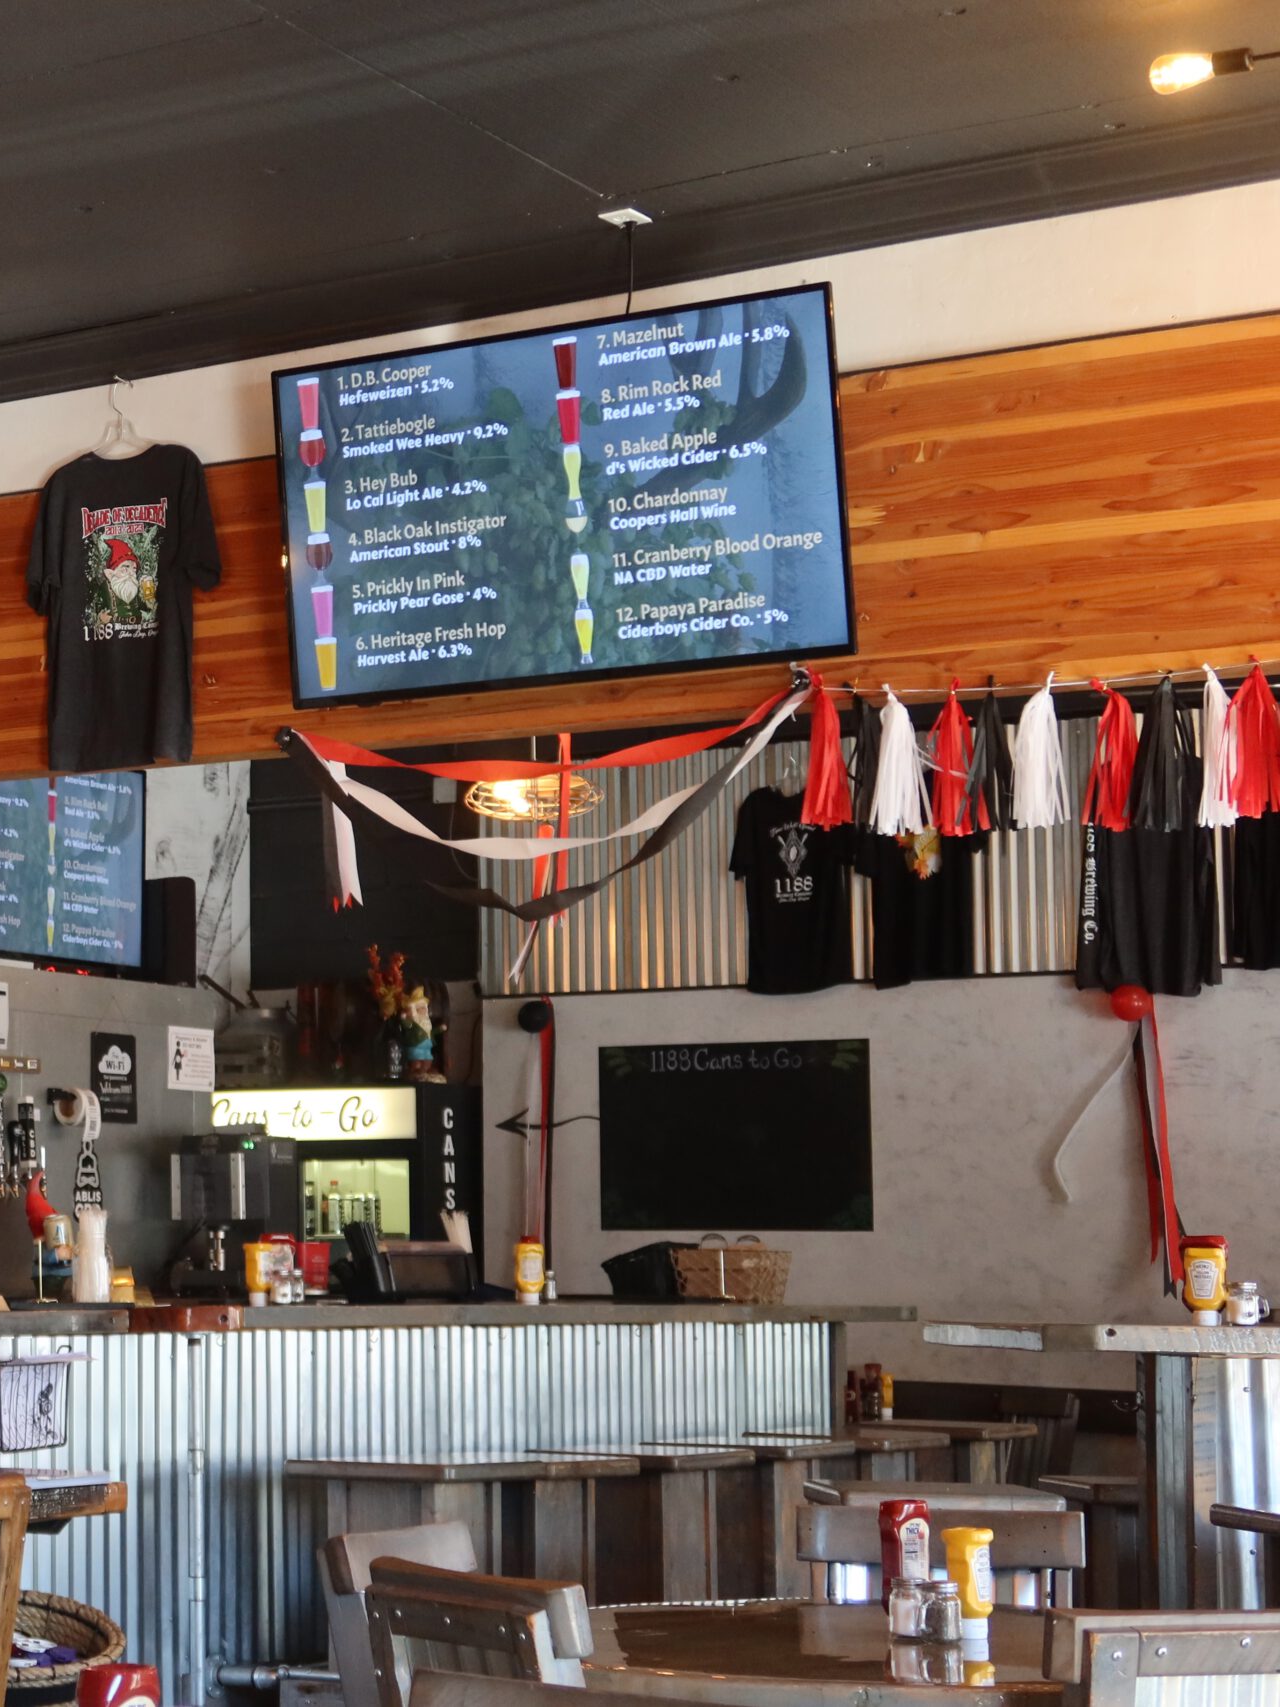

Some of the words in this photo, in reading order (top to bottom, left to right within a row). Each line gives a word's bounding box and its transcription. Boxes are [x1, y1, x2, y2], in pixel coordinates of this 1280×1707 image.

[597, 334, 610, 349] 7.
[613, 323, 684, 347] Mazelnut
[599, 342, 666, 366] American
[669, 337, 715, 355] Brown
[719, 333, 742, 347] Ale
[752, 325, 790, 342] 5.8%
[337, 376, 348, 390] 1.
[352, 373, 379, 388] D.B.
[382, 364, 431, 384] Cooper
[602, 389, 615, 404] 8.
[618, 383, 648, 401] Rim
[652, 376, 689, 395] Rock
[693, 371, 721, 389] Red
[340, 384, 412, 406] Hefeweizen
[421, 378, 454, 393] 5.2%
[603, 405, 629, 422] Red
[632, 401, 654, 416] Ale
[665, 396, 700, 412] 5.5%
[341, 428, 353, 442] 2.
[356, 415, 435, 440] Tattiebogle
[343, 443, 393, 458] Smoked
[396, 436, 422, 449] Wee
[425, 429, 464, 447] Heavy
[474, 424, 508, 439] 9.2%
[604, 444, 617, 459] 9.
[621, 433, 668, 456] Baked
[672, 428, 717, 453] Apple
[606, 459, 625, 476] d's
[629, 454, 679, 473] Wicked
[682, 450, 719, 465] Cider
[729, 442, 767, 458] 6.5%
[345, 481, 357, 494] 3.
[360, 477, 387, 493] Hey
[390, 470, 417, 484] Bub
[346, 496, 360, 511] Lo
[364, 492, 384, 507] Cal
[387, 488, 419, 507] Light
[422, 486, 442, 502] Ale
[452, 480, 486, 496] 4.2%
[608, 498, 631, 513] 10.
[634, 487, 727, 512] Chardonnay
[349, 532, 361, 546] 4.
[365, 526, 401, 544] Black
[404, 523, 432, 537] Oak
[436, 515, 507, 536] Instigator
[610, 512, 667, 531] Coopers
[670, 507, 697, 523] Hall
[701, 504, 736, 519] Wine
[350, 544, 410, 563] American
[414, 539, 449, 554] Stout
[458, 537, 481, 549] 8%
[613, 553, 631, 568] 11.
[634, 541, 711, 565] Cranberry
[715, 534, 760, 554] Blood
[763, 531, 823, 551] Orange
[352, 585, 364, 598] 5.
[367, 577, 412, 598] Prickly
[417, 576, 430, 590] In
[433, 571, 465, 587] Pink
[614, 571, 633, 585] NA
[637, 568, 666, 582] CBD
[670, 563, 712, 577] Water
[354, 597, 398, 615] Prickly
[401, 596, 429, 609] Pear
[432, 591, 463, 605] Gose
[473, 587, 497, 600] 4%
[616, 607, 637, 622] 12.
[640, 599, 697, 621] Papaya
[699, 593, 765, 613] Paradise
[356, 636, 368, 650] 6.
[371, 629, 432, 649] Heritage
[435, 623, 473, 642] Fresh
[476, 622, 506, 639] Hop
[618, 620, 687, 640] Ciderboys
[690, 616, 727, 632] Cider
[731, 614, 754, 626] Co.
[764, 609, 788, 624] 5%
[357, 650, 406, 666] Harvest
[409, 649, 429, 661] Ale
[438, 643, 472, 658] 6.3%
[775, 876, 813, 893] 1188
[1082, 857, 1098, 917] Brewing
[105, 1060, 125, 1070] Wi-Fi
[650, 1050, 691, 1072] 1188
[694, 1048, 743, 1071] Cans
[749, 1050, 769, 1069] to
[773, 1048, 802, 1069] Go
[443, 1107, 456, 1210] CANS
[75, 1191, 101, 1202] ABLIS
